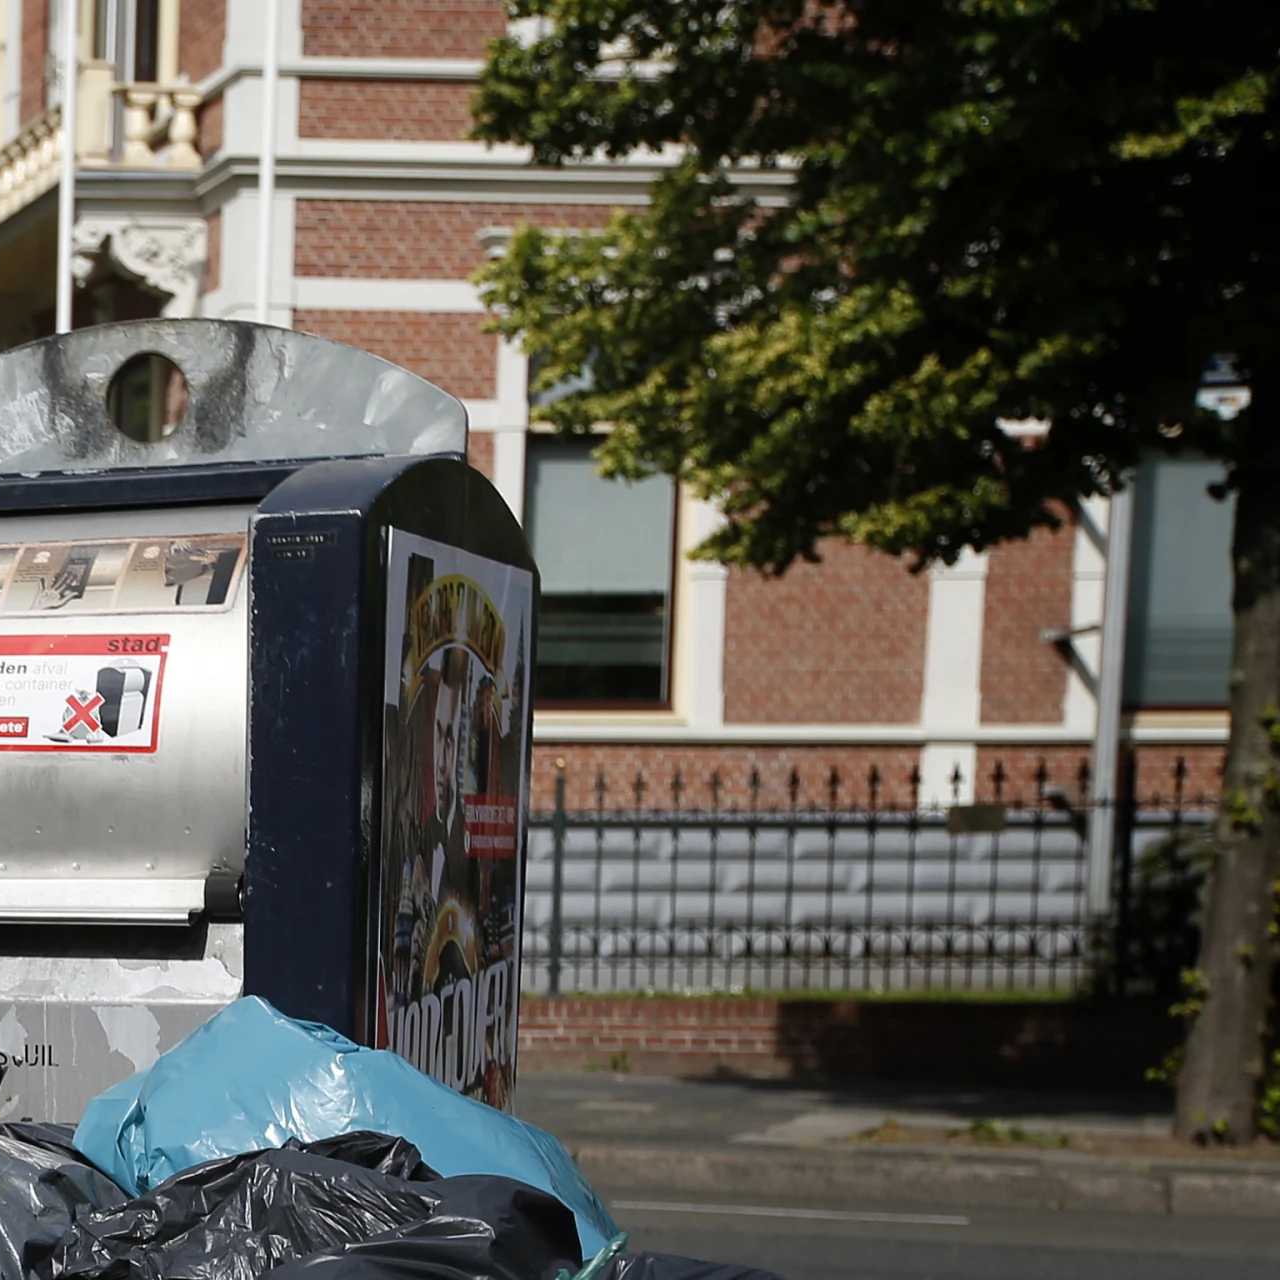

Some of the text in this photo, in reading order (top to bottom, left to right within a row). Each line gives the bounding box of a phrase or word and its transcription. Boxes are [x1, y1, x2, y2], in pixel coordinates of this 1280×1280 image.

[107, 637, 160, 653] stad
[33, 661, 68, 675] afval
[5, 679, 73, 691] container
